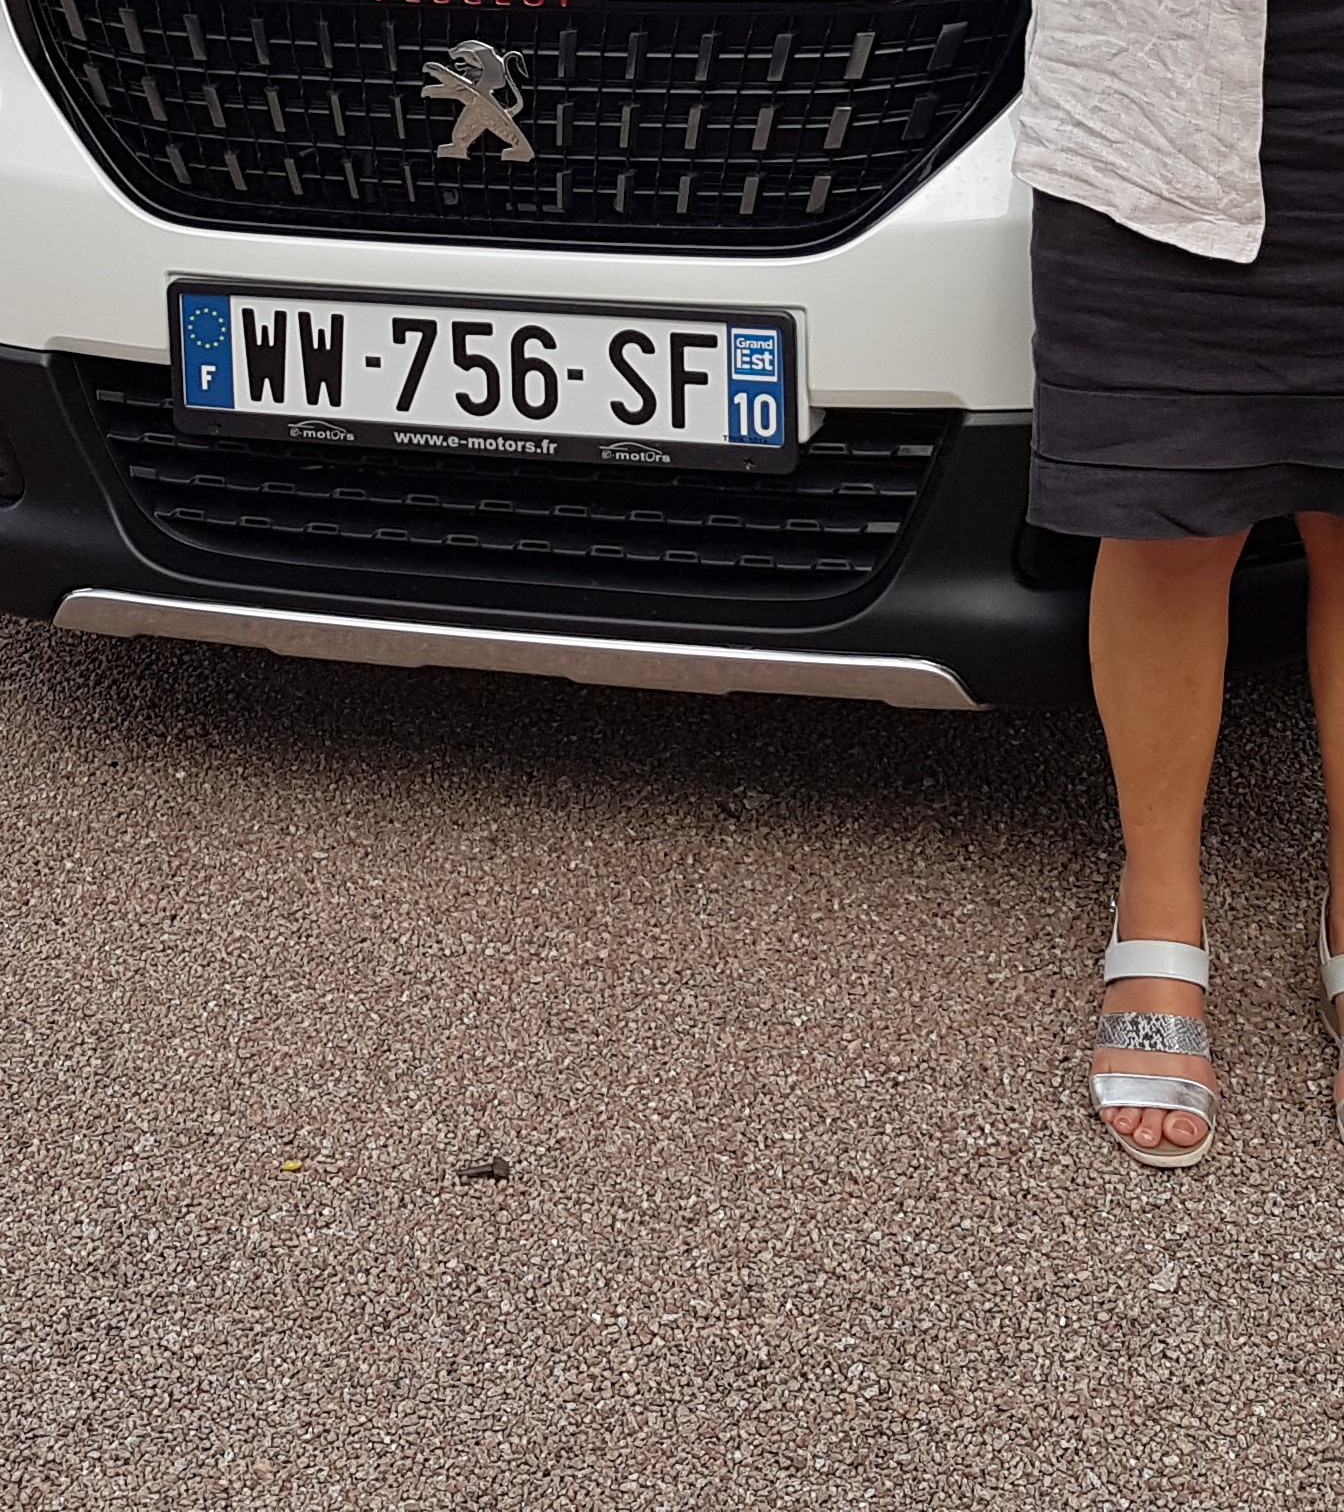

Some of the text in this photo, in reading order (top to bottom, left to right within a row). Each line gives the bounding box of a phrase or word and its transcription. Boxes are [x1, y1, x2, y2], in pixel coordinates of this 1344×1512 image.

[736, 337, 773, 350] Grand
[736, 349, 774, 371] Est
[200, 365, 217, 391] F
[734, 392, 777, 437] 10
[393, 431, 557, 455] www.e-motors.fr
